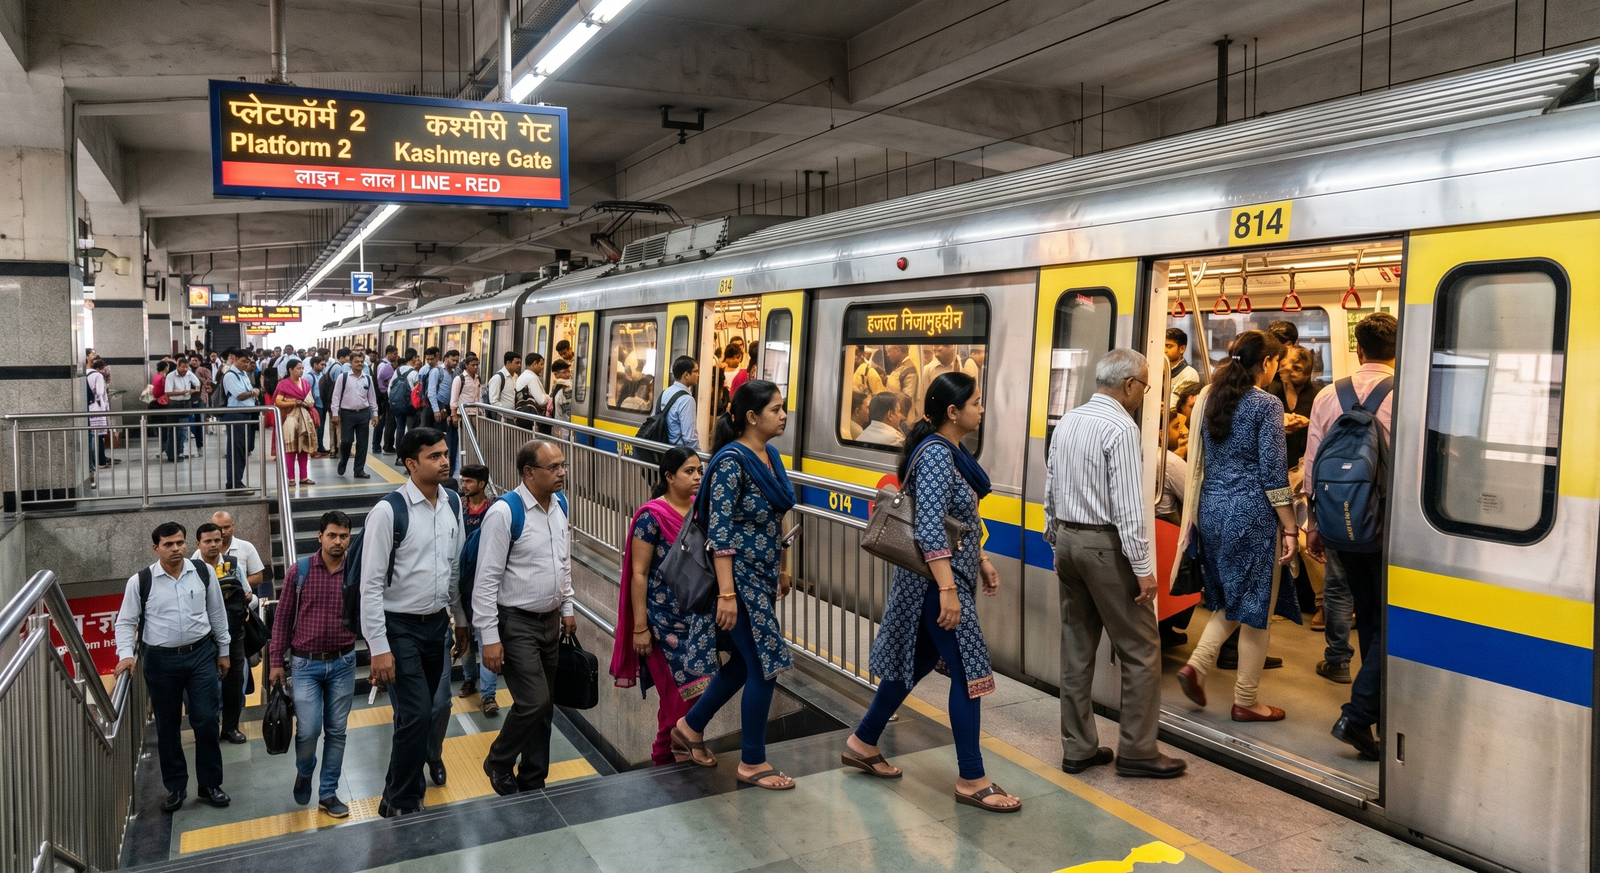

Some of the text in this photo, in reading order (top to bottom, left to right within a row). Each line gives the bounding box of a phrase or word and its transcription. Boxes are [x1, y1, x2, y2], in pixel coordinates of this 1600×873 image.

[229, 93, 366, 132] प्लेटफॉर्म 2
[424, 110, 552, 143] कश्मीरी गेट
[230, 132, 352, 159] Platform 2
[394, 142, 553, 170] Kashmere Gate
[294, 169, 340, 187] लाइन
[361, 172, 396, 188] लाल
[410, 174, 451, 191] LINE
[465, 177, 501, 193] RED
[1234, 207, 1283, 239] 814
[357, 278, 369, 292] 2
[719, 279, 733, 293] 814
[867, 304, 964, 336] हजरत निजामुद्दीन
